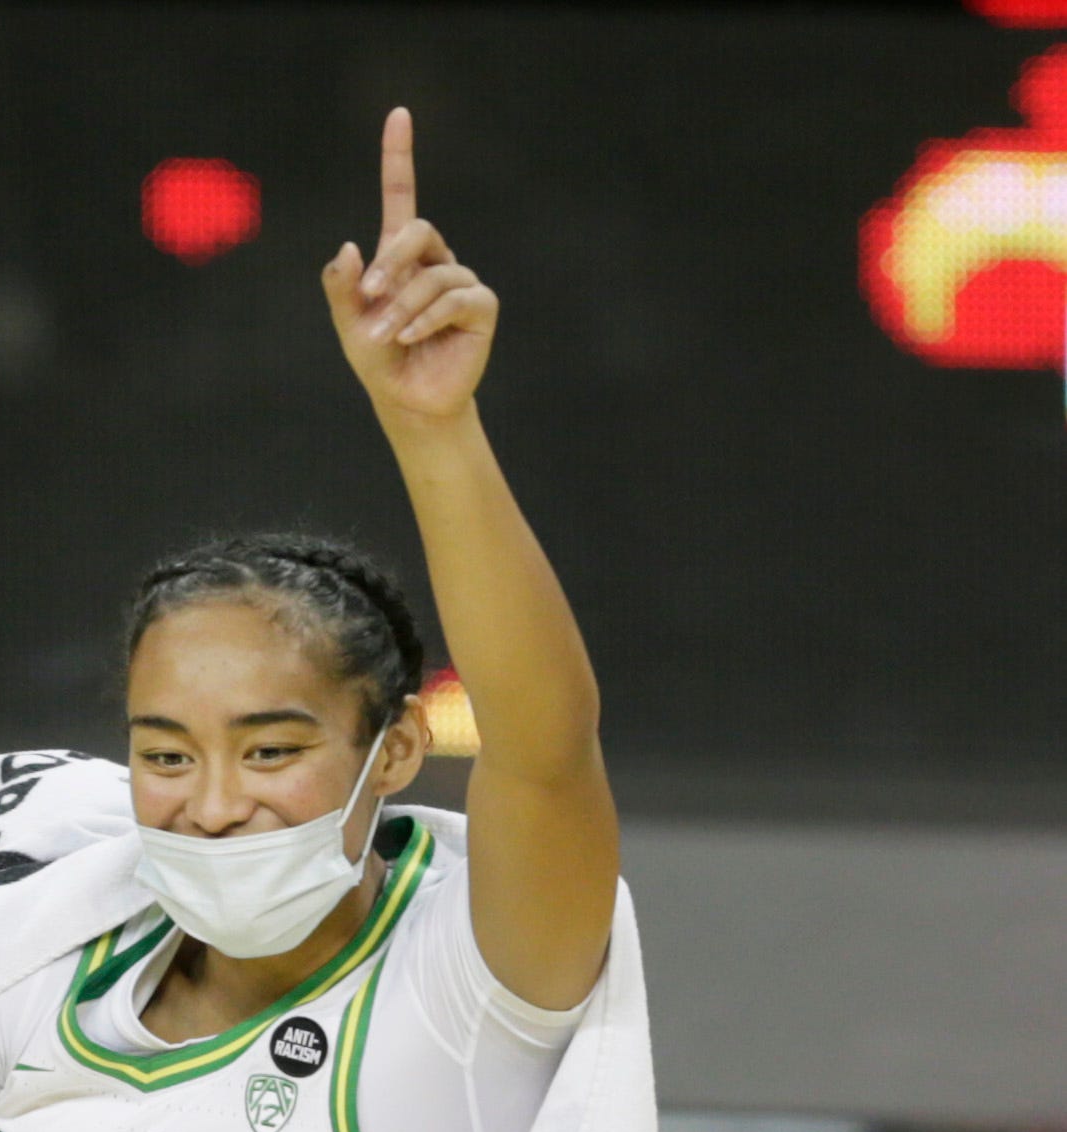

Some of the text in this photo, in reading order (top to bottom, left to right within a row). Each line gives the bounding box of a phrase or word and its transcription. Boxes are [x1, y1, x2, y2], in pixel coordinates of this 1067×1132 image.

[283, 1026, 320, 1047] ANTI-
[275, 1039, 322, 1065] RACISM
[248, 1079, 295, 1117] PAC
[254, 1104, 278, 1128] 12
